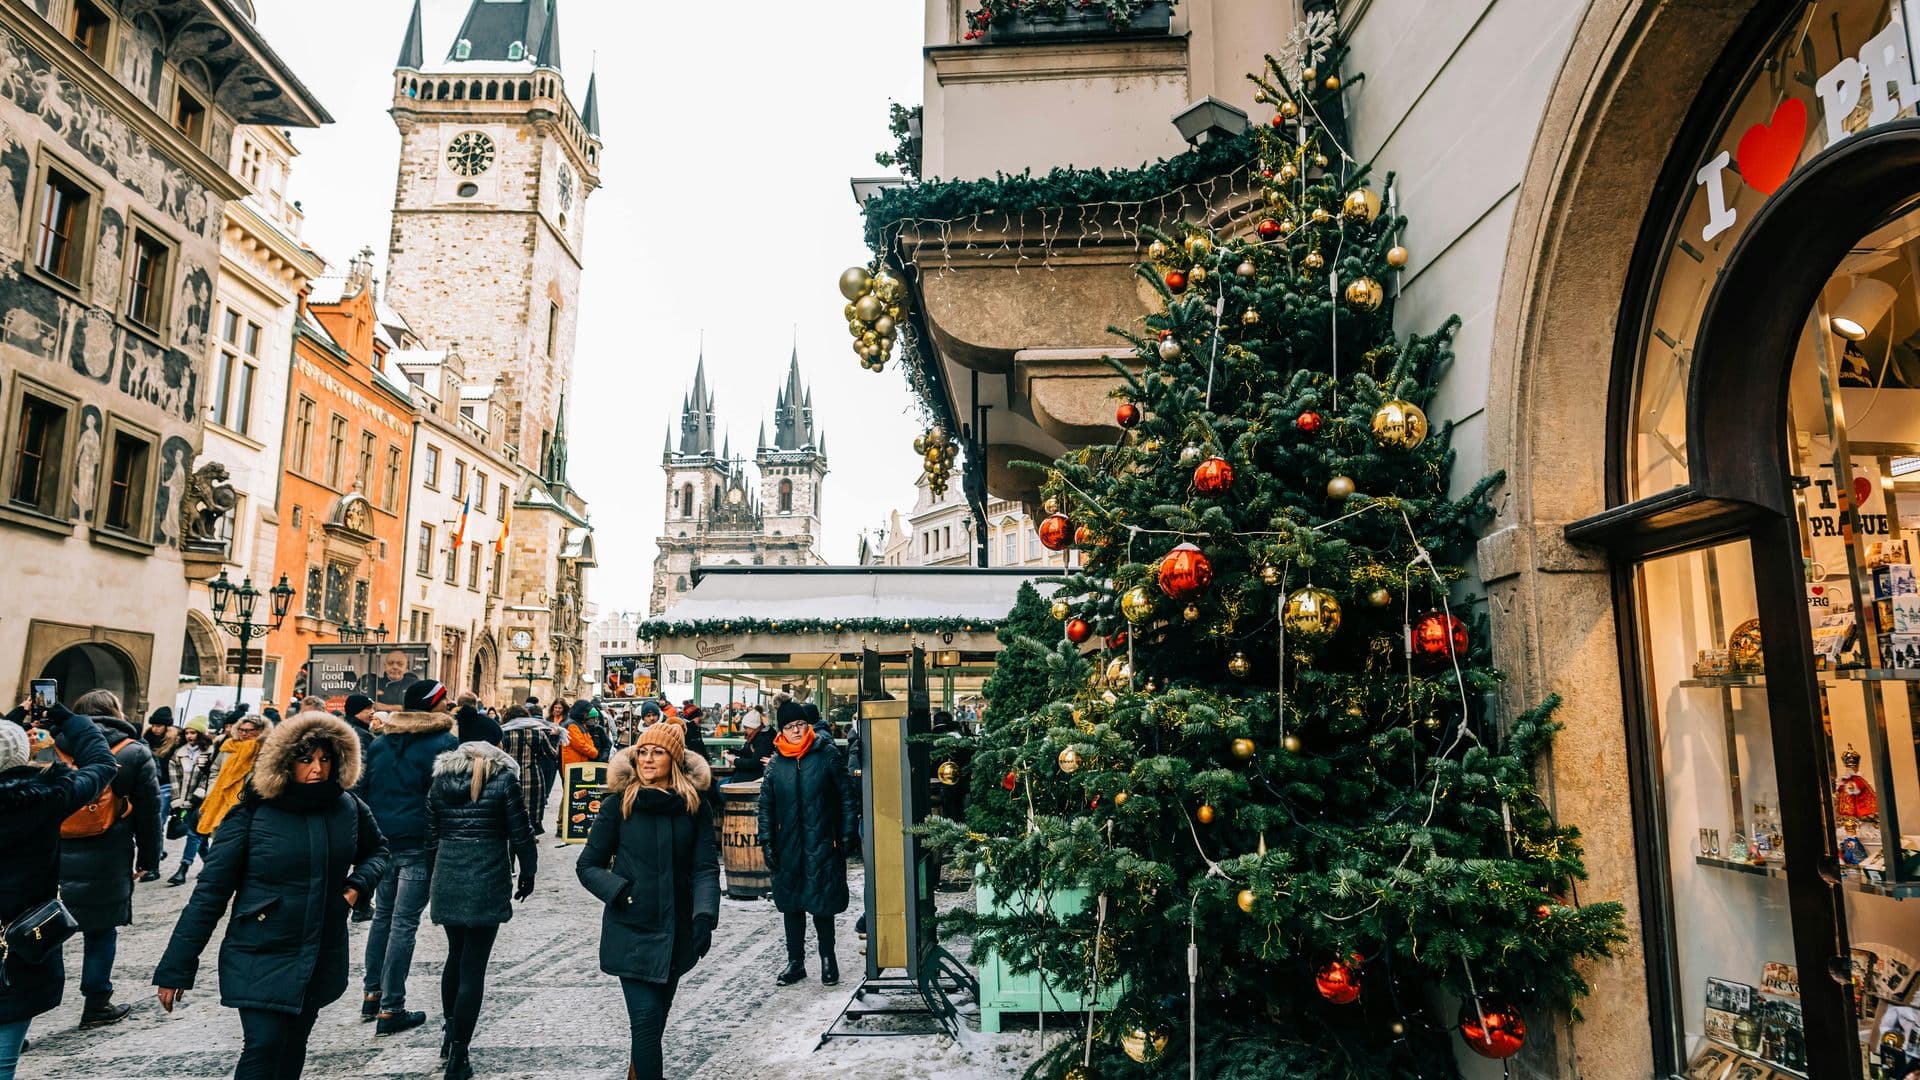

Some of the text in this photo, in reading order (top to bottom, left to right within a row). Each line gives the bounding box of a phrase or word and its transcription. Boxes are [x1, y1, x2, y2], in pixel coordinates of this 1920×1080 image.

[1697, 150, 1736, 242] I
[1815, 479, 1837, 509] I
[322, 663, 354, 672] Italian
[322, 672, 344, 680] food
[321, 680, 357, 691] quality
